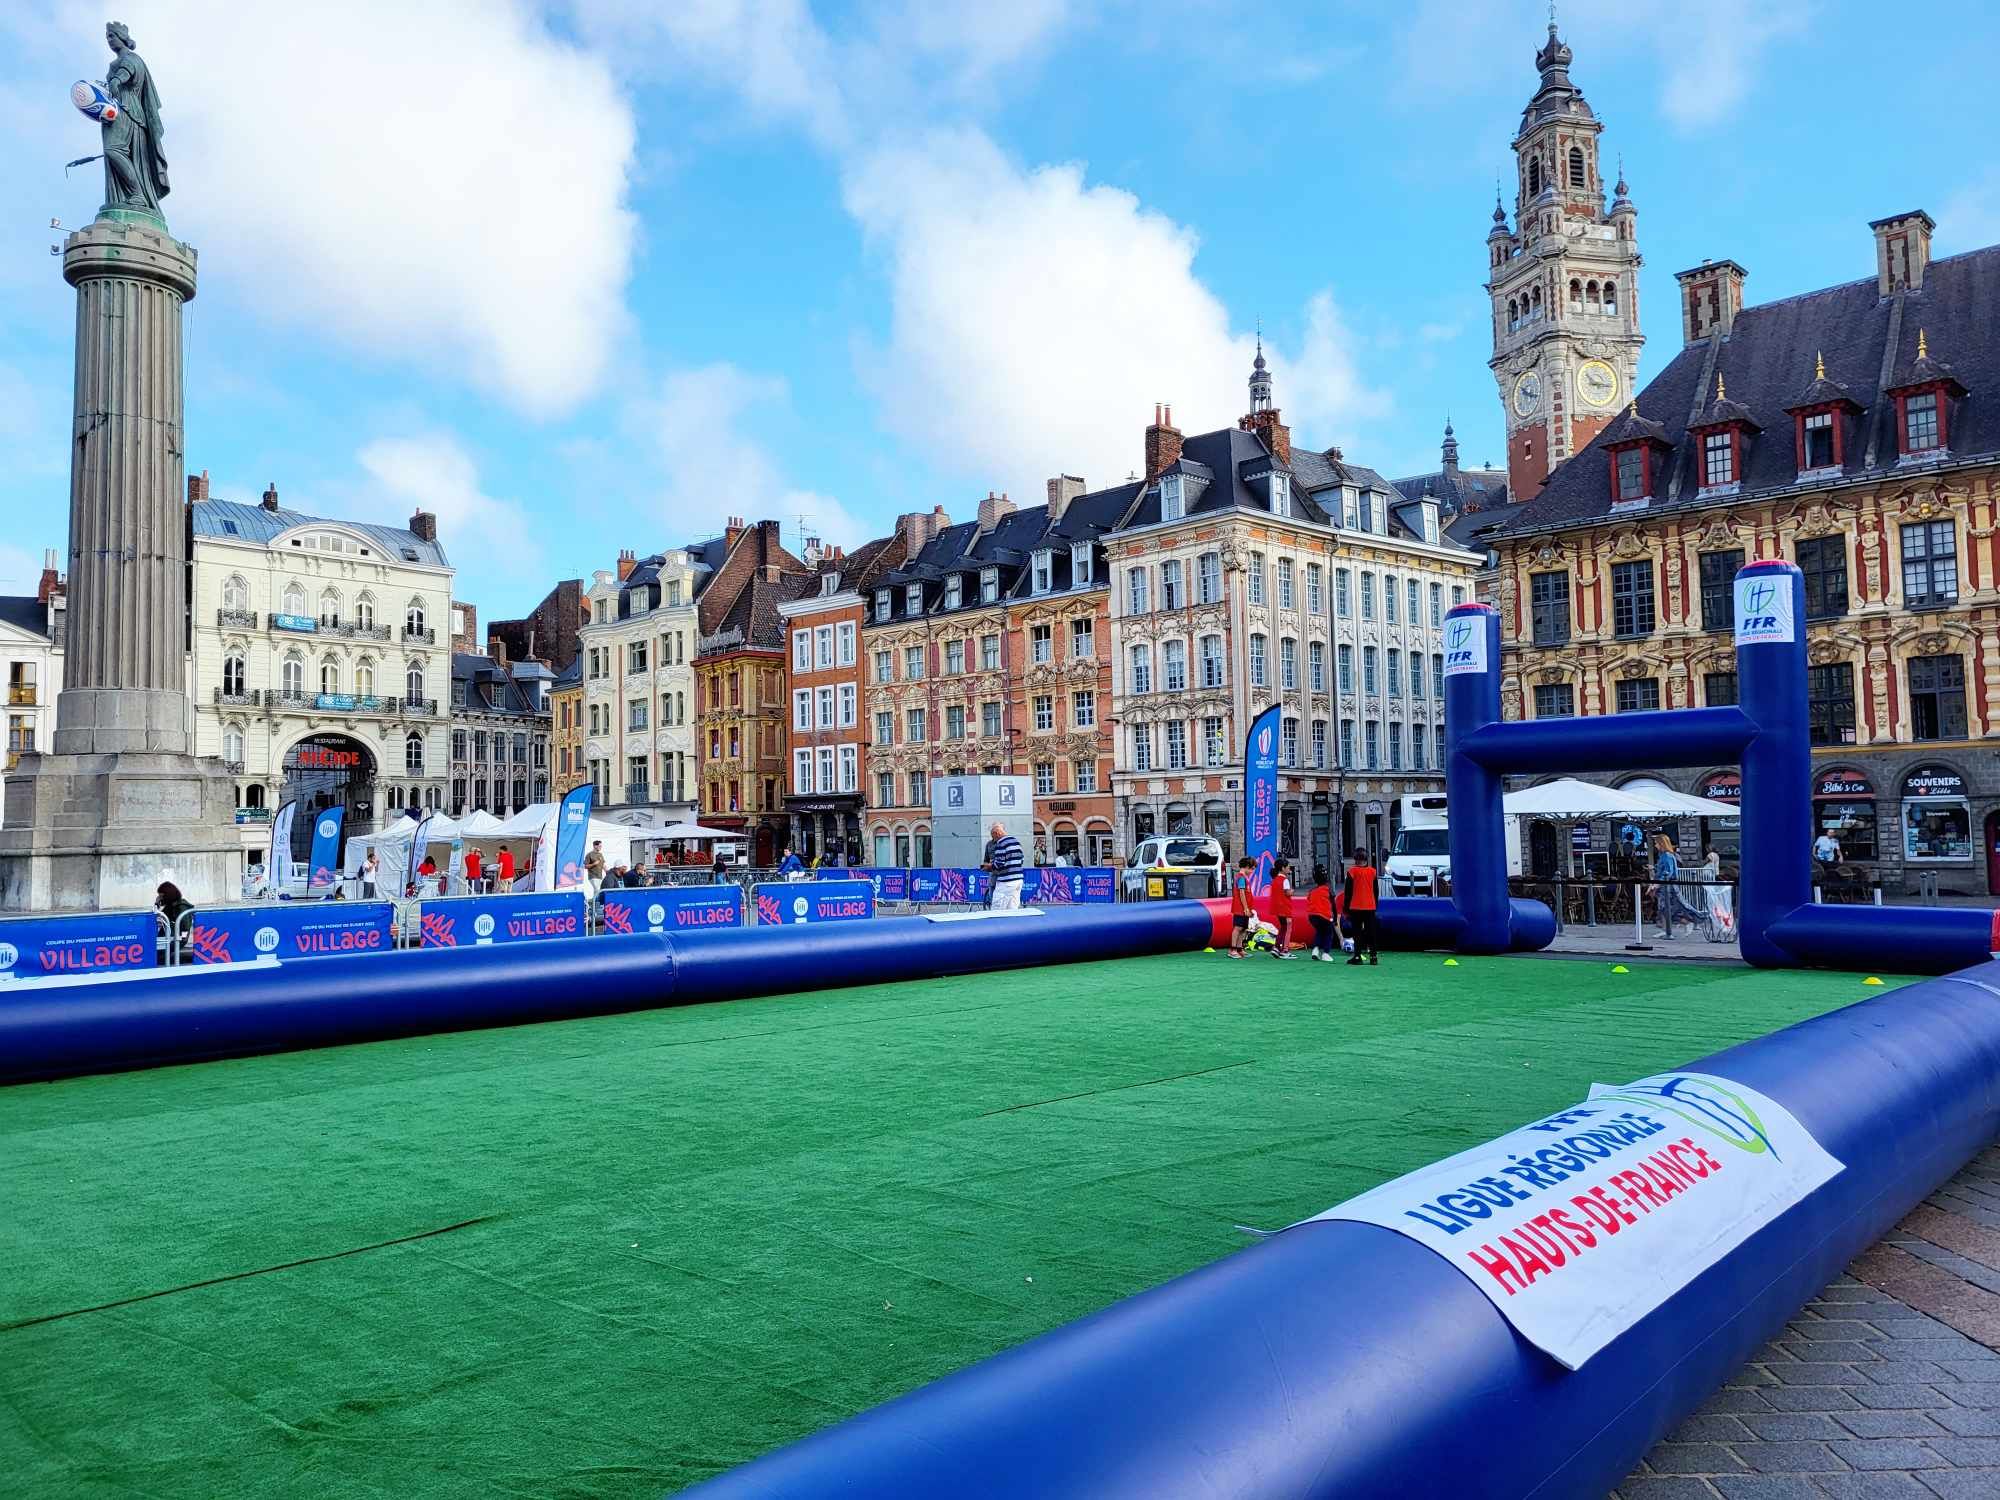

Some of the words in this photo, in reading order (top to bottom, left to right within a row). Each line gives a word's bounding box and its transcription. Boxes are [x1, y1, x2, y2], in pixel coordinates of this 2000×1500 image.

[1743, 616, 1776, 630] FFR
[1447, 651, 1472, 663] FFR
[1822, 781, 1850, 794] Bibi's
[1907, 777, 1961, 787] SOUVENIRS
[1929, 787, 1951, 795] Lille
[1404, 1176, 1533, 1236] LIGUE
[1500, 1112, 1667, 1190] RÉGIONALE
[1467, 1137, 1723, 1297] HAUTS-DE-FRANCE
